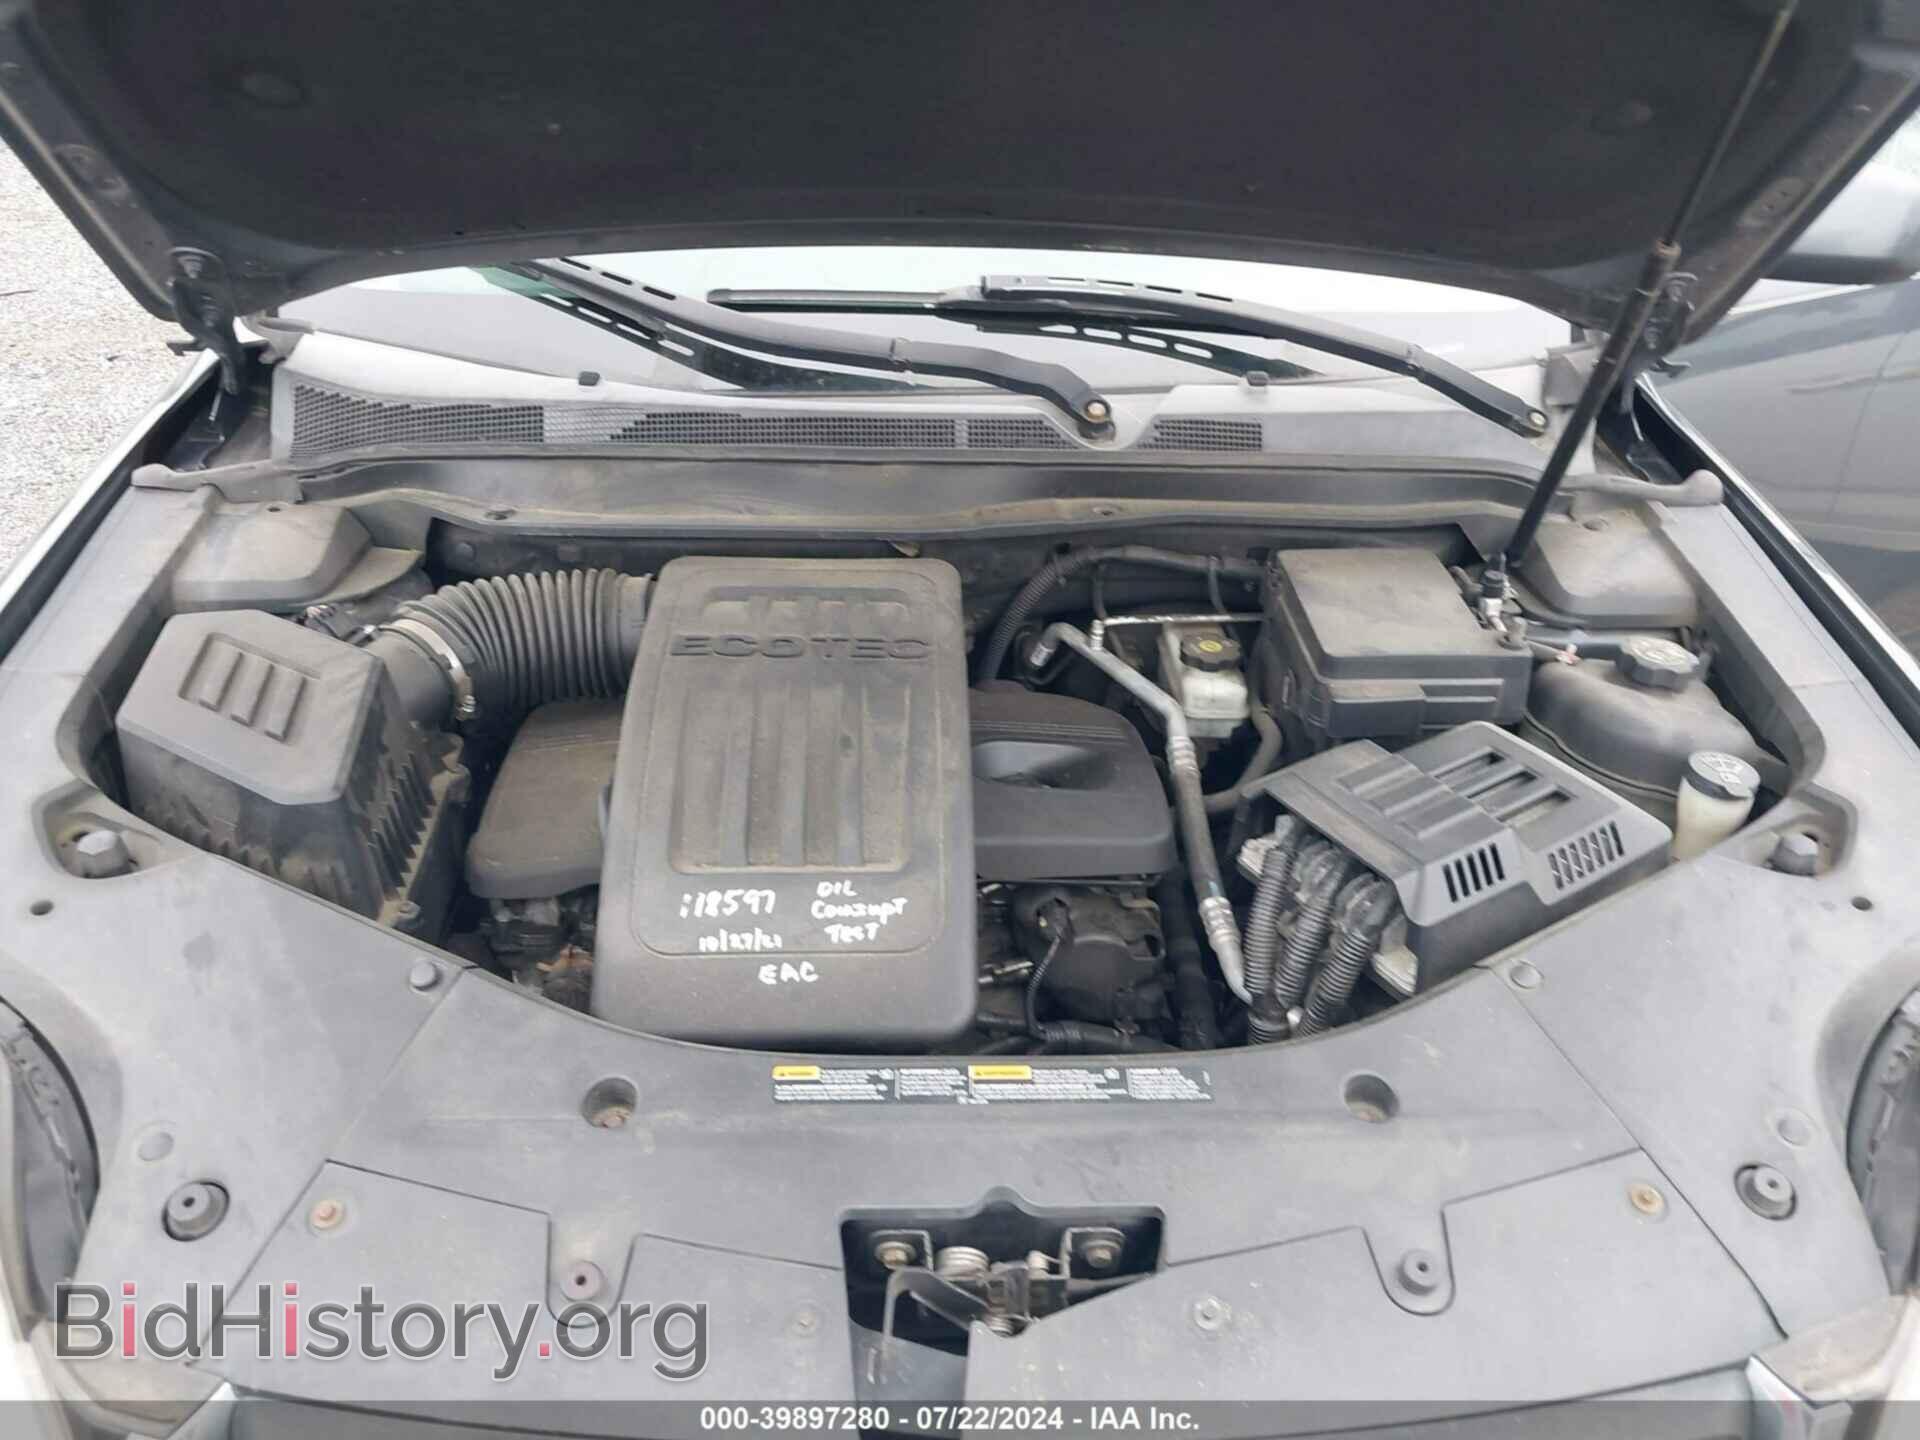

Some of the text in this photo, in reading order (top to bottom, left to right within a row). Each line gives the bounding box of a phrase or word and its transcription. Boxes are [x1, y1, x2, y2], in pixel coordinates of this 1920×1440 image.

[669, 635, 932, 659] ECOTEC
[816, 879, 857, 898] OIL
[758, 961, 819, 985] EAC
